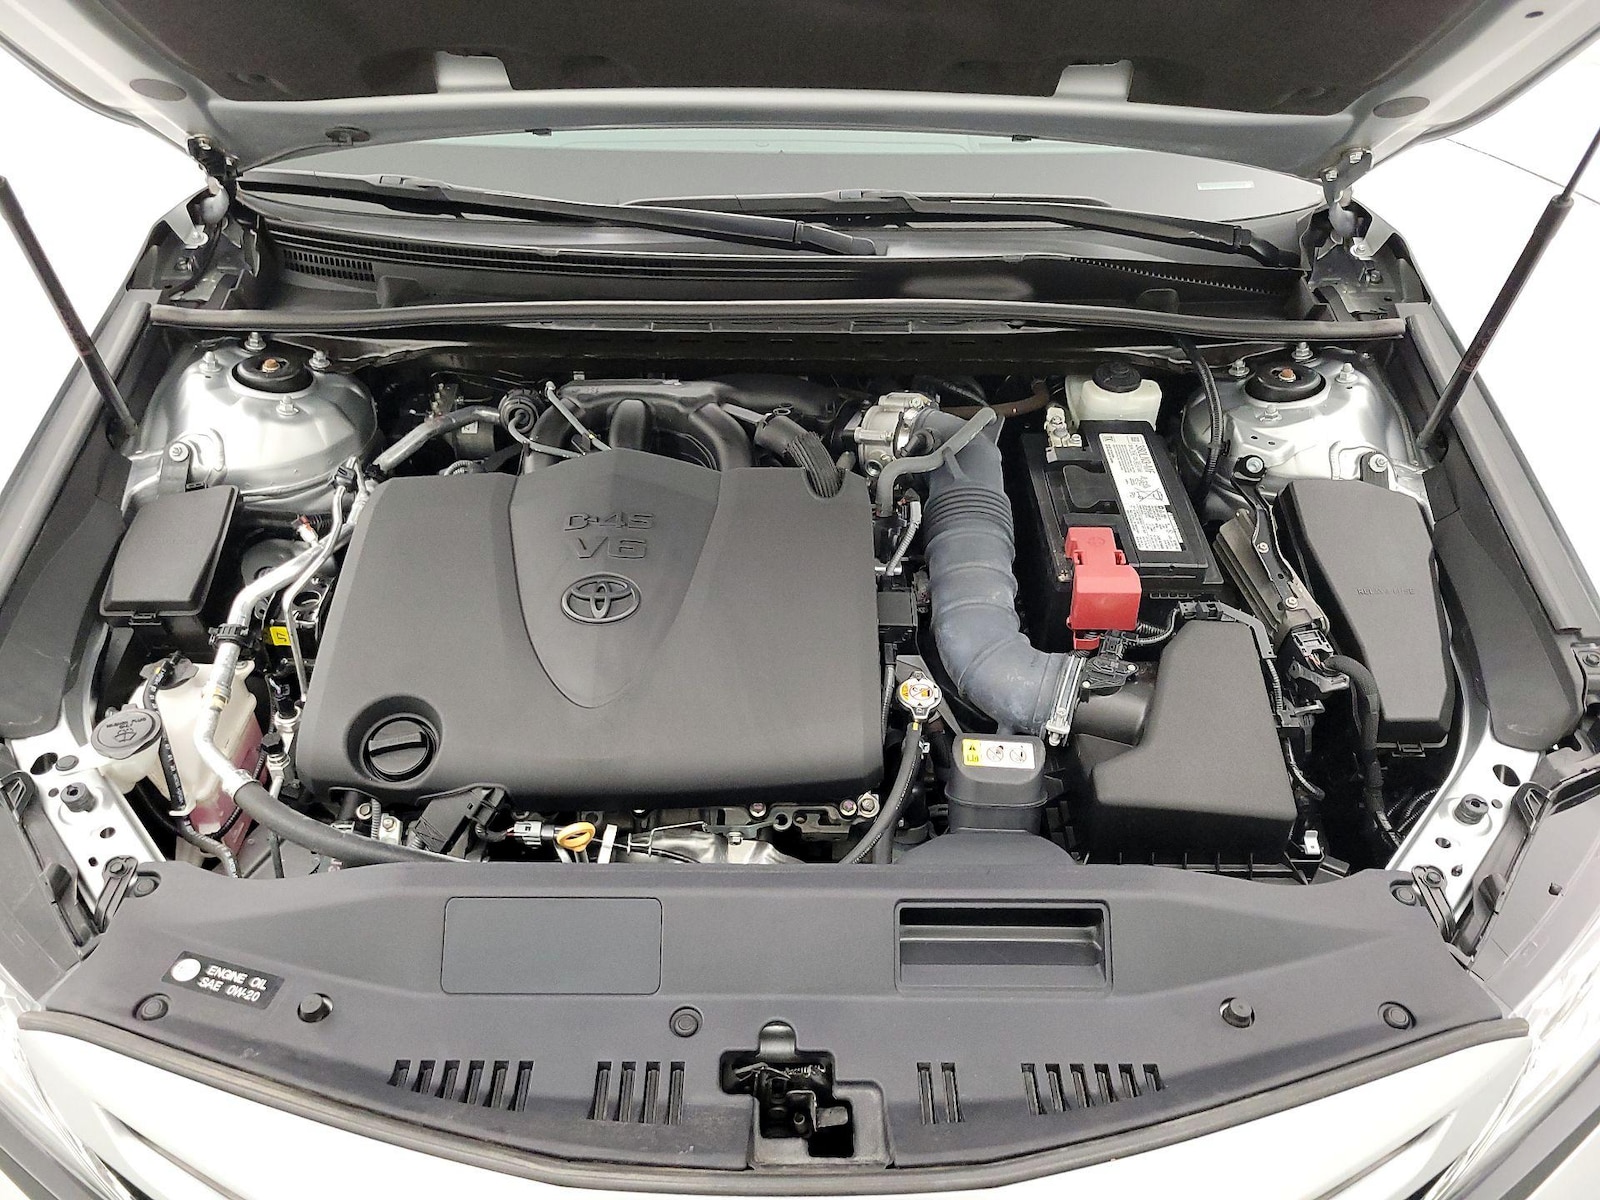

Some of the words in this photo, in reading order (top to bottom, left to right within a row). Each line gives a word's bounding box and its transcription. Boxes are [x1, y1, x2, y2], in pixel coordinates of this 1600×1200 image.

[574, 534, 647, 560] V6
[198, 977, 224, 992] SAE
[226, 985, 261, 1002] 0W-20
[205, 965, 248, 984] ENGINE
[249, 977, 268, 990] OIL
